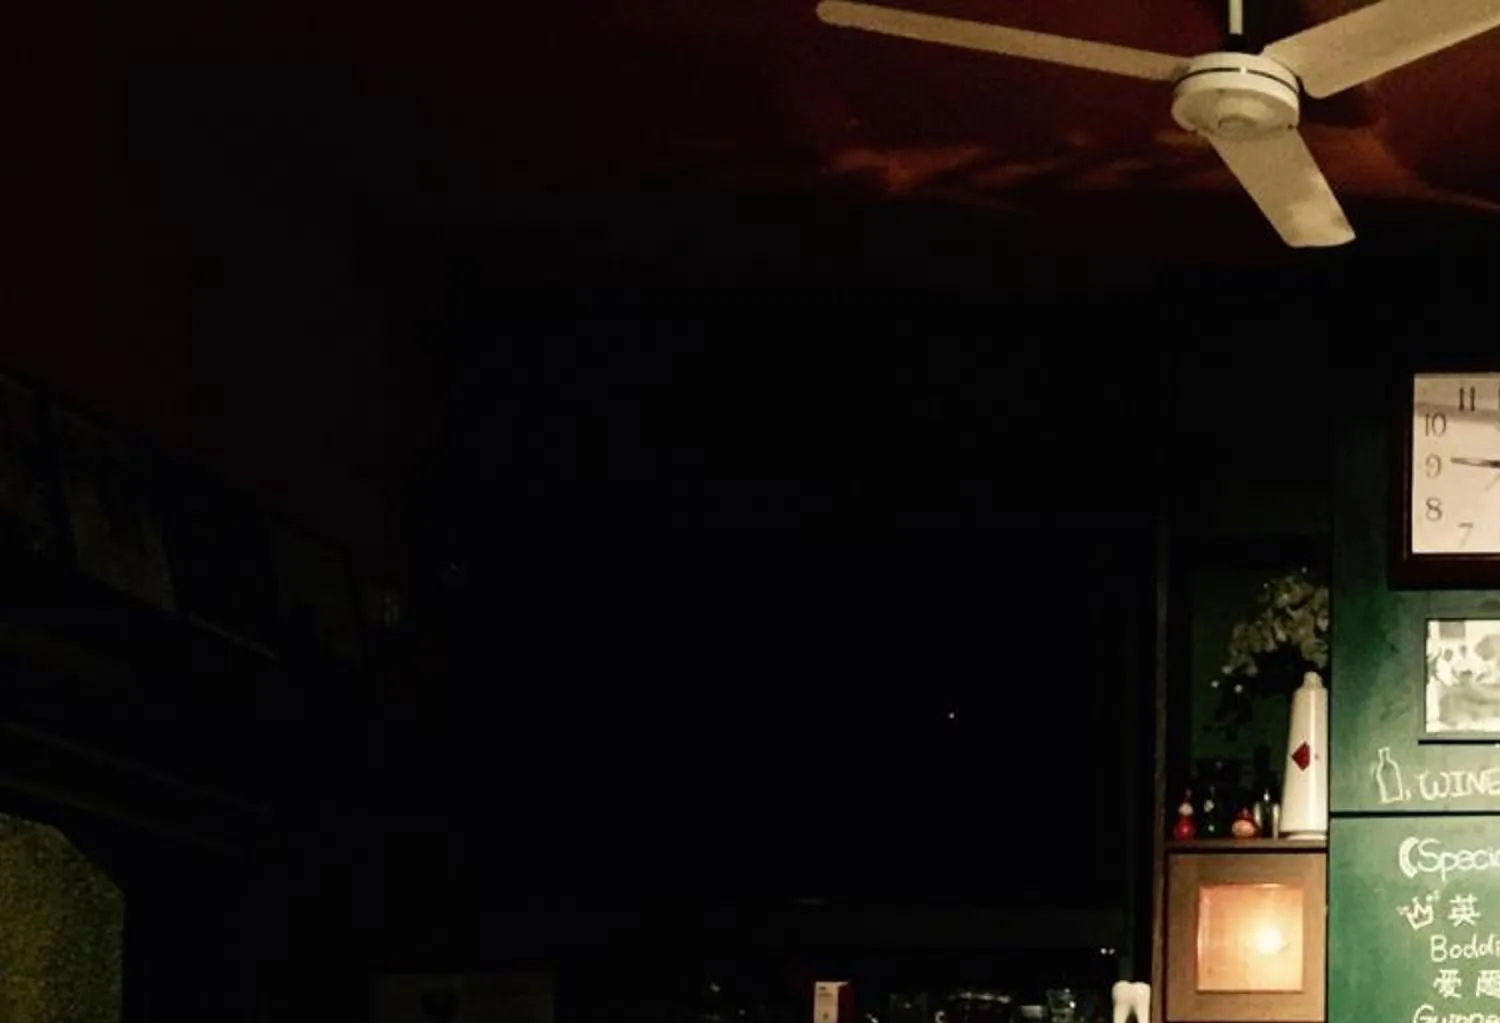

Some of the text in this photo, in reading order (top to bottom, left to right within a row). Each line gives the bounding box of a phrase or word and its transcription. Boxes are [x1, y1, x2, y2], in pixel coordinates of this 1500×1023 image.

[1459, 385, 1476, 412] 11
[1424, 412, 1447, 437] 10
[1425, 454, 1442, 478] 9
[1425, 497, 1442, 522] 8
[1458, 522, 1474, 547] 7
